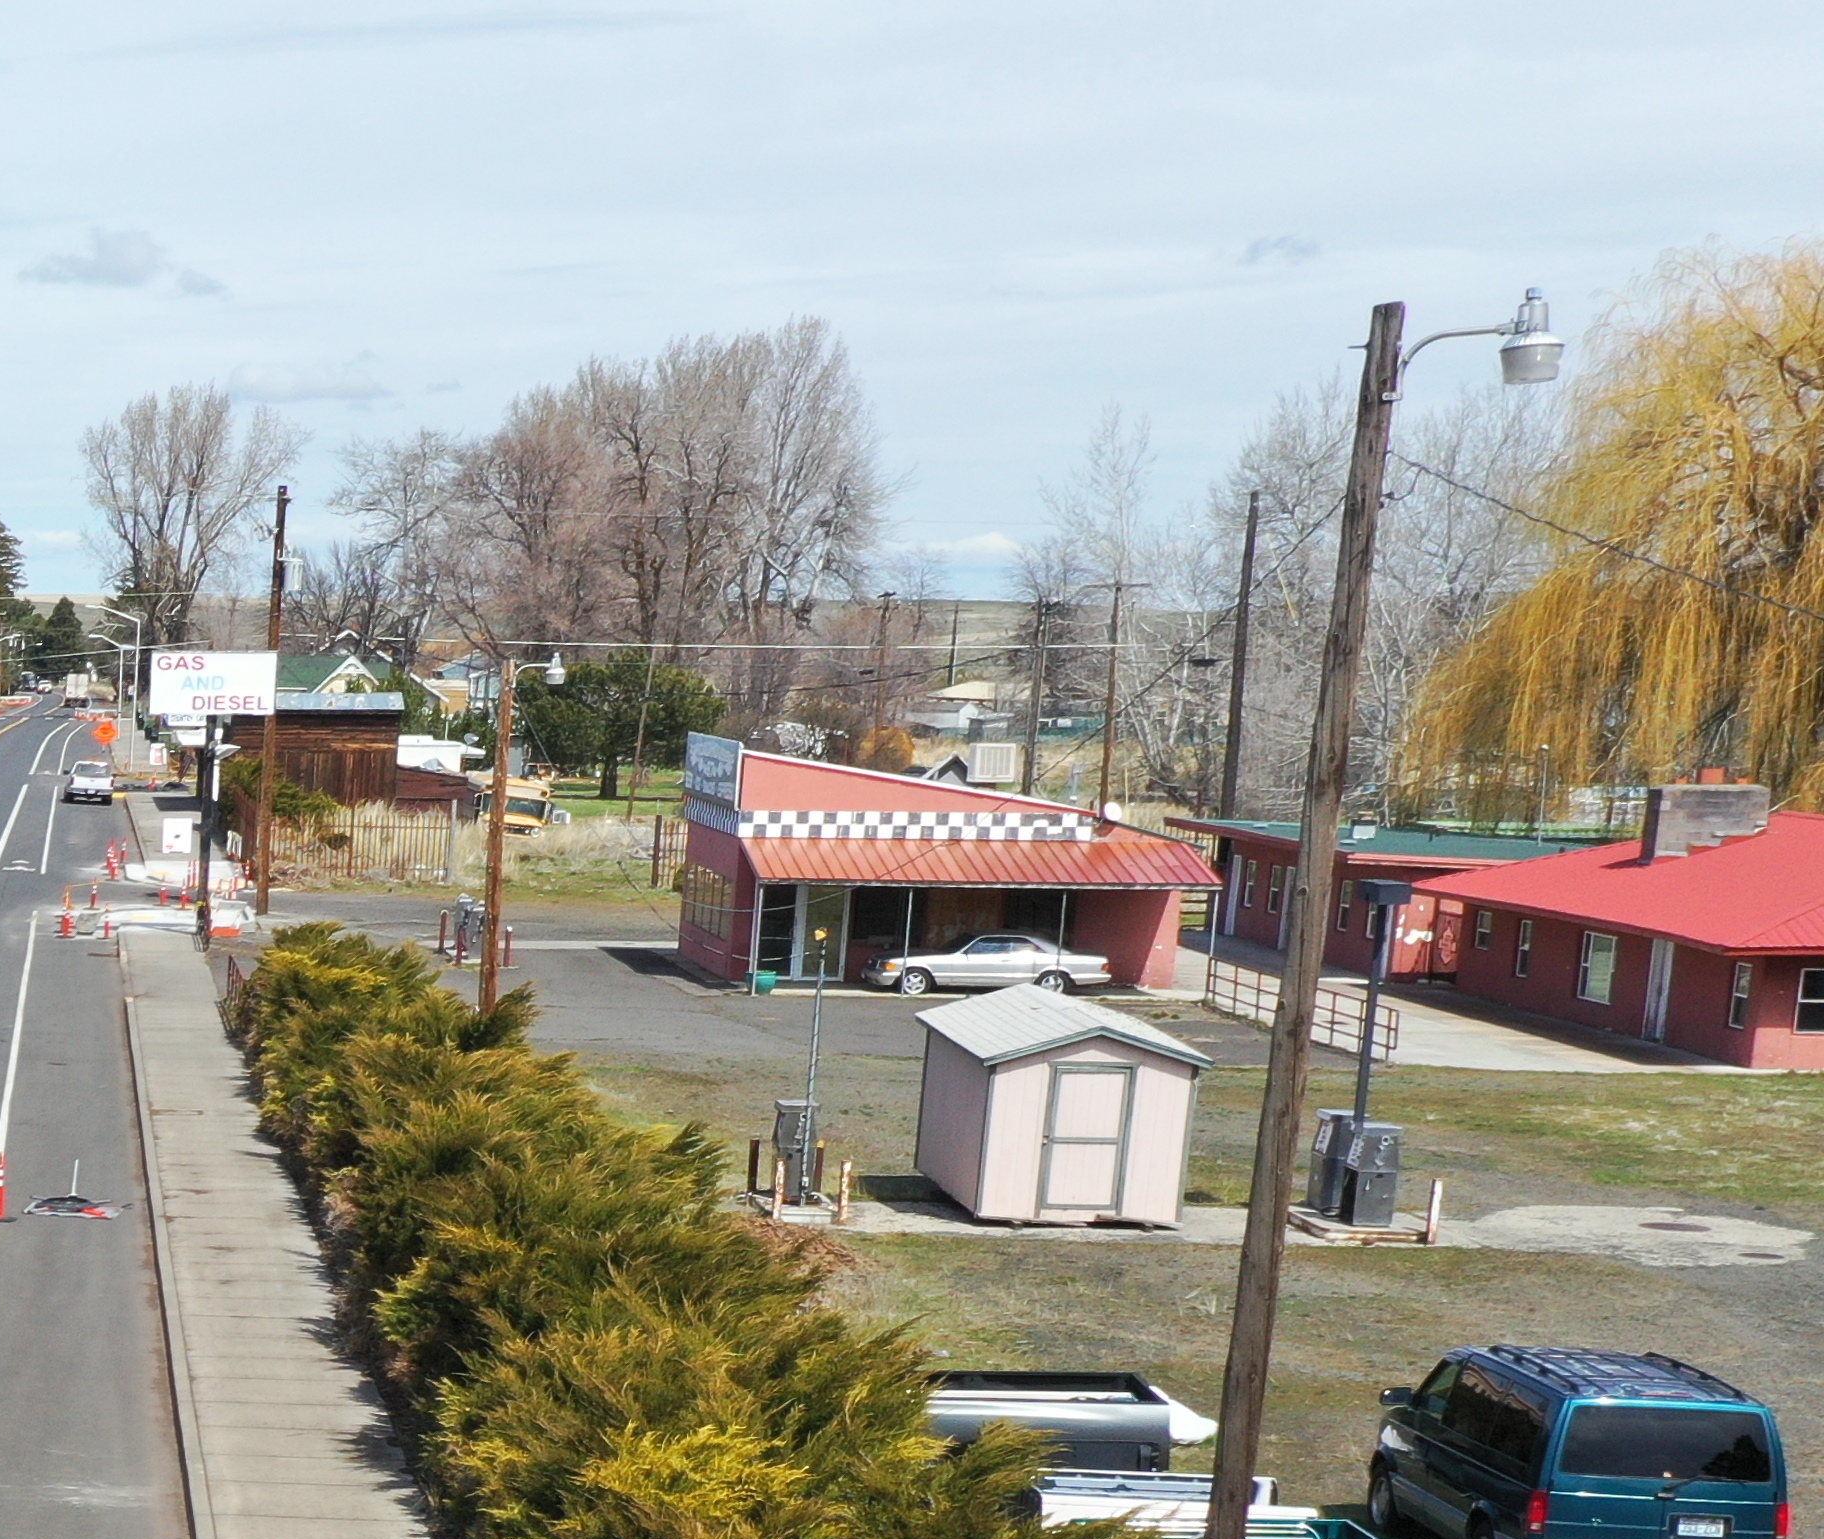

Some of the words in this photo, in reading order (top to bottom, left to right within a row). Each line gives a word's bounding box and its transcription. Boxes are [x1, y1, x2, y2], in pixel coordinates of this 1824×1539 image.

[157, 656, 205, 671] GAS
[180, 675, 225, 691] AND
[192, 695, 268, 711] DIESEL
